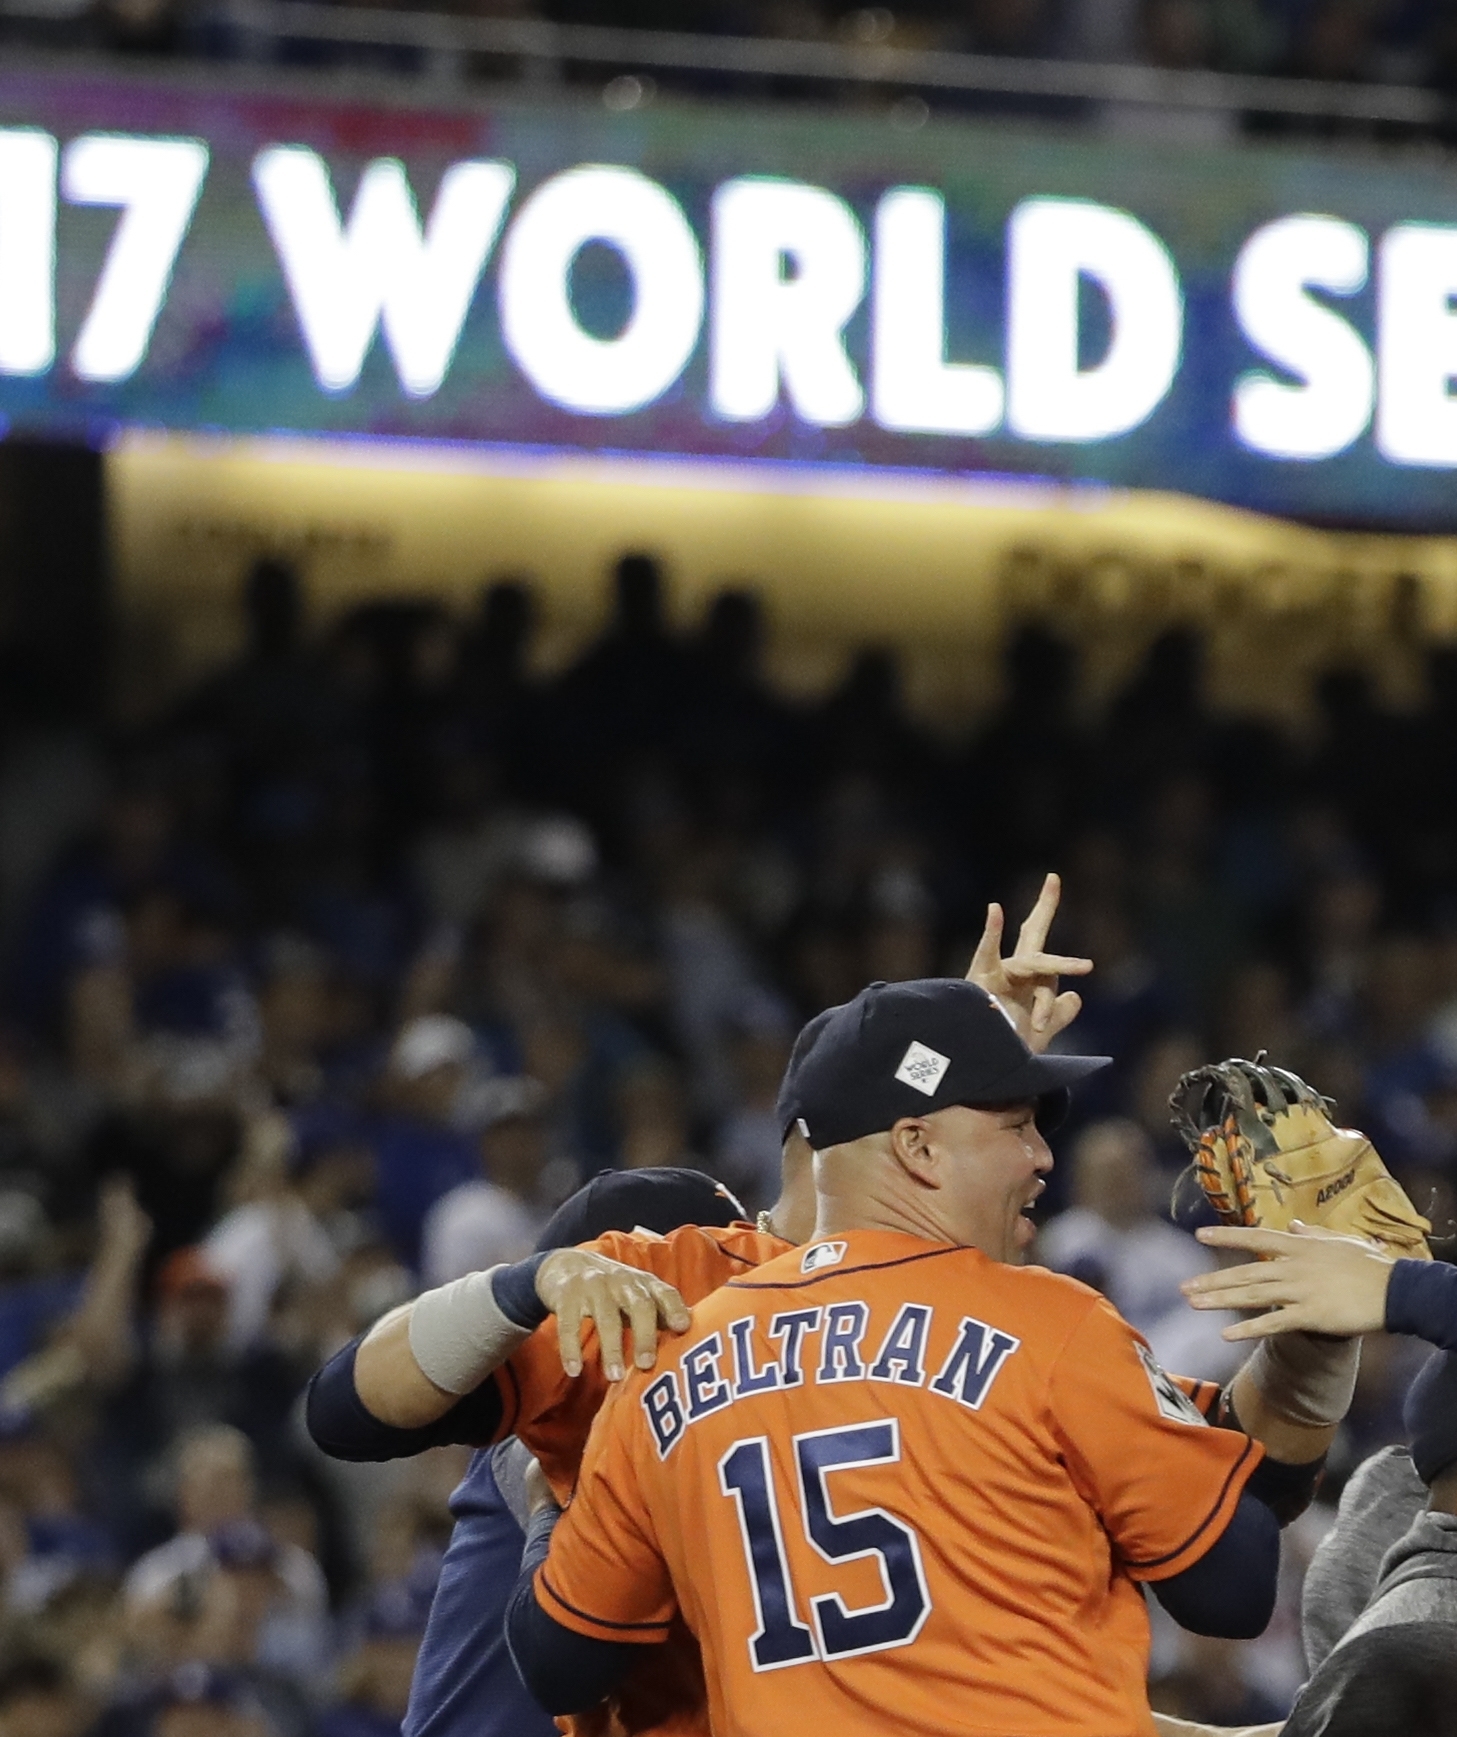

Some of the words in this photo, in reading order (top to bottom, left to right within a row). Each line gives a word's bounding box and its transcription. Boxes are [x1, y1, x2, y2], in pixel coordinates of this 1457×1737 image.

[254, 148, 1183, 442] WORLD
[640, 1300, 1021, 1462] BELTRAN
[717, 1417, 933, 1673] 15
